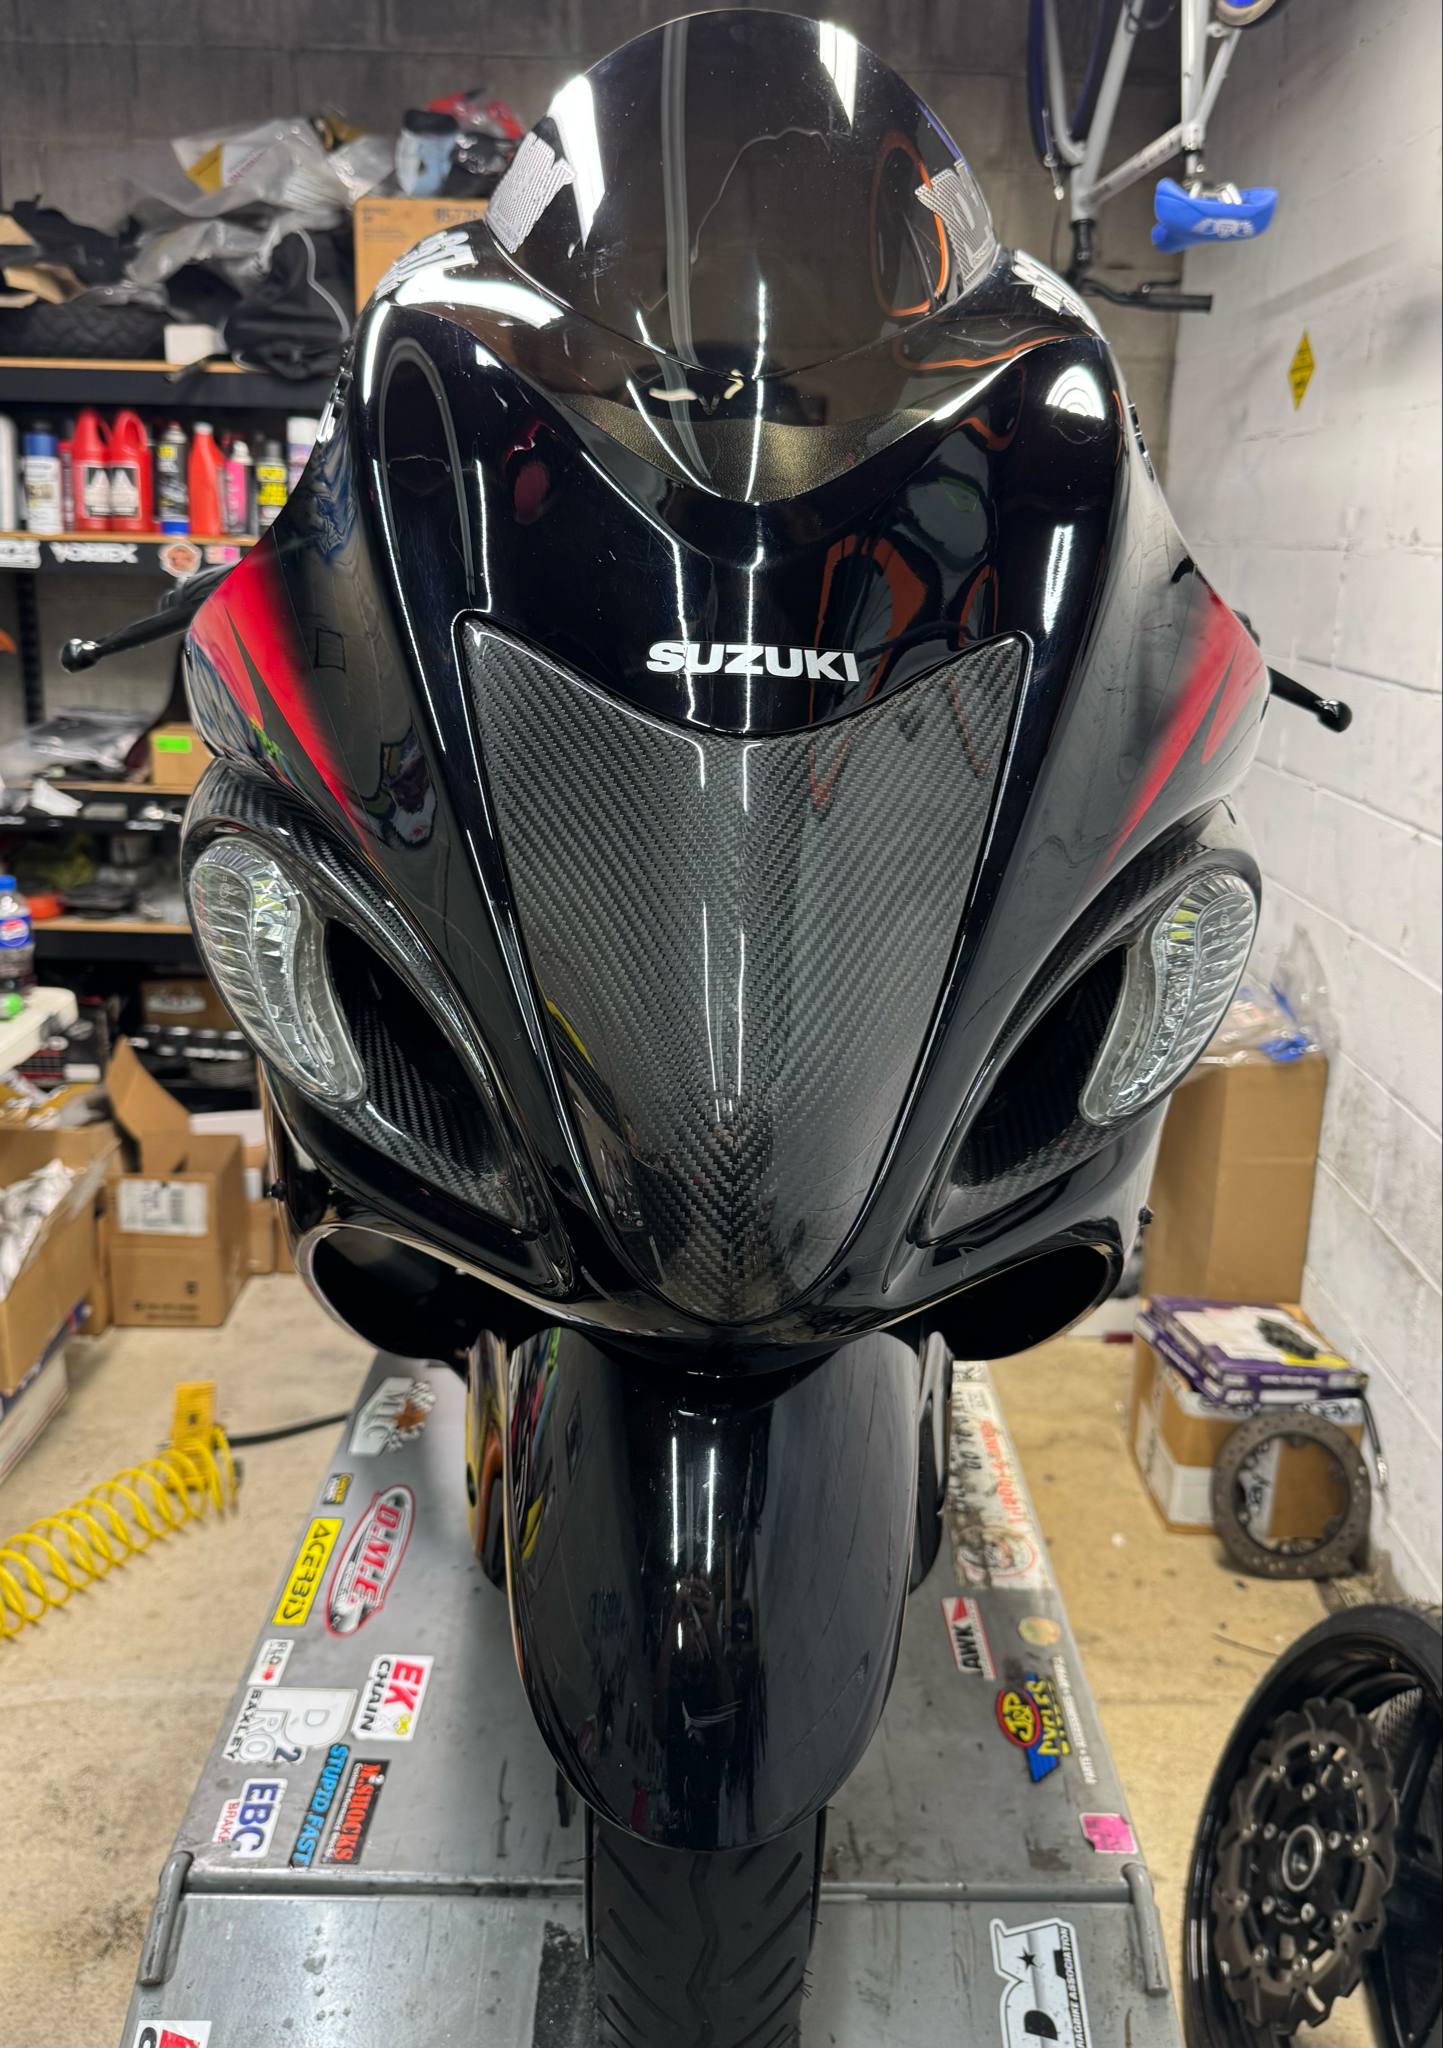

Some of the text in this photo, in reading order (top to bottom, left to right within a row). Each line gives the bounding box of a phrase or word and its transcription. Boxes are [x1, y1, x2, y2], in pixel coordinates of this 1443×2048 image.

[646, 642, 860, 682] SUZUKI
[359, 1660, 391, 1732] CHAIN
[384, 1661, 425, 1712] EK
[232, 1783, 280, 1852] EBC
[293, 1743, 350, 1868] STUPID FAST
[1060, 1926, 1087, 2048] RAGBIKE ASSOCIATION
